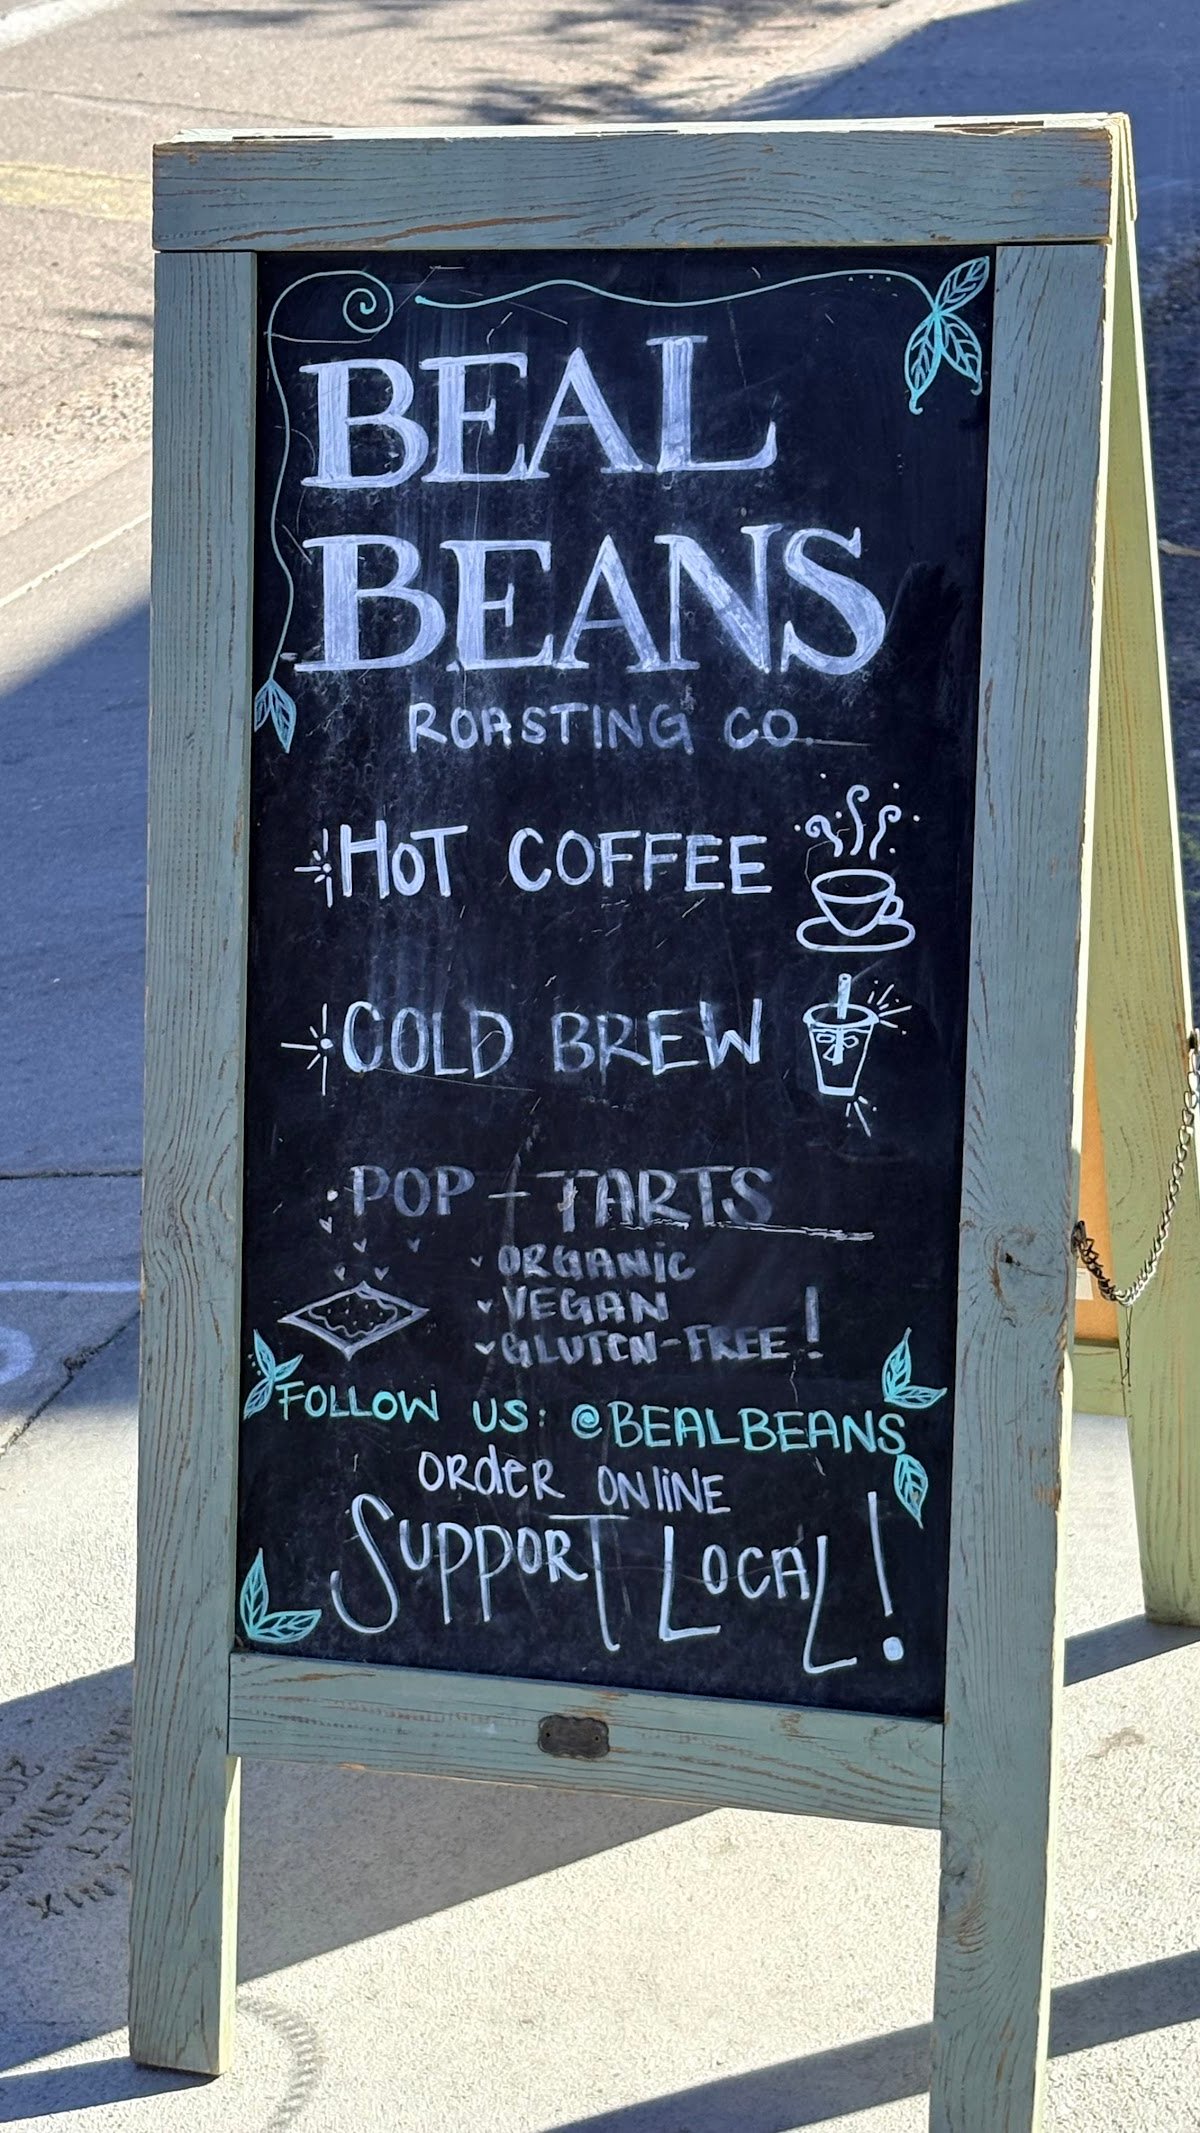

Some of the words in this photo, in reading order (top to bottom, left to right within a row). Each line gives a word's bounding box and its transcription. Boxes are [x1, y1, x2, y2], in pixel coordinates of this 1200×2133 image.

[299, 335, 776, 488] BEAL
[293, 523, 887, 675] BEANS
[409, 702, 694, 755] ROASTING
[508, 827, 772, 895] COFFEE
[342, 1001, 514, 1079] COLD
[551, 998, 763, 1076] BREW
[502, 1285, 669, 1325] VEGAN
[275, 1380, 440, 1423] FOLLOW
[571, 1400, 906, 1454] @BEALBEANS
